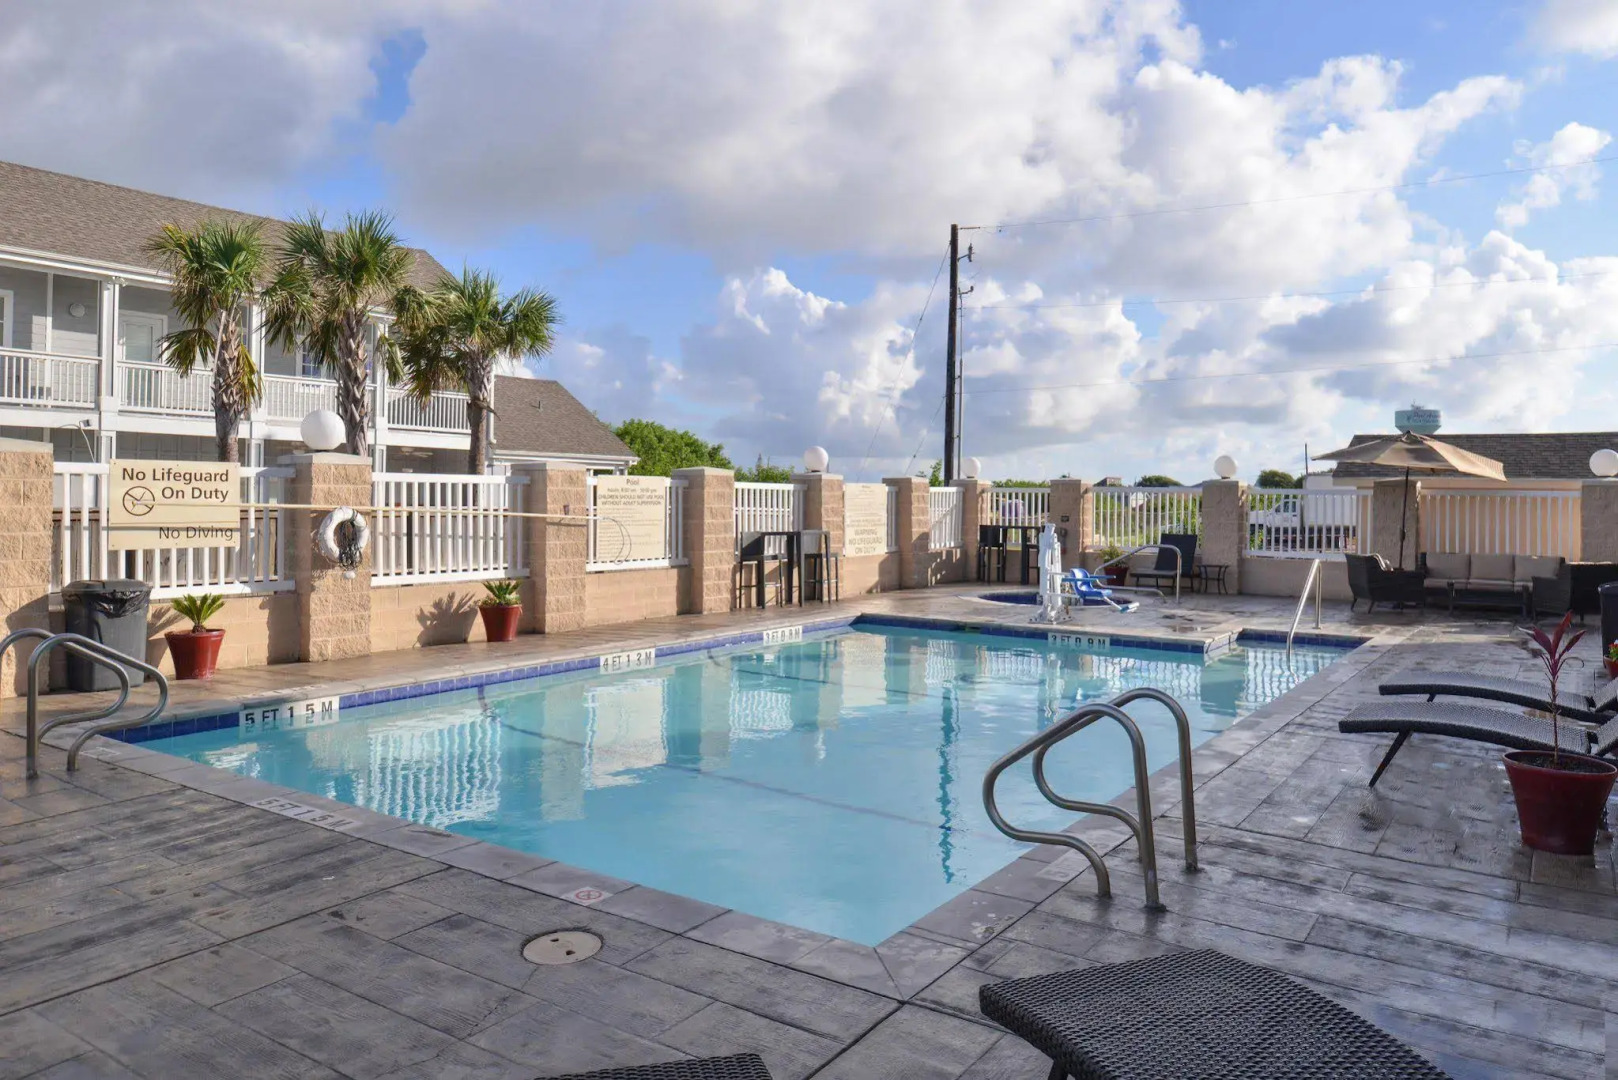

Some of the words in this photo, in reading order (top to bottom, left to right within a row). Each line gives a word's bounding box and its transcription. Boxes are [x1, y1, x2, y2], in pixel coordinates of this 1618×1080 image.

[122, 467, 146, 481] No
[152, 467, 229, 485] Lifeguard
[161, 486, 185, 500] On
[191, 486, 229, 503] Duty
[158, 526, 180, 540] No
[186, 525, 233, 541] Diving
[612, 655, 622, 665] FT
[245, 712, 256, 725] 5
[261, 708, 280, 722] FT
[288, 705, 294, 718] 1
[305, 703, 315, 715] 5
[321, 700, 333, 713] M
